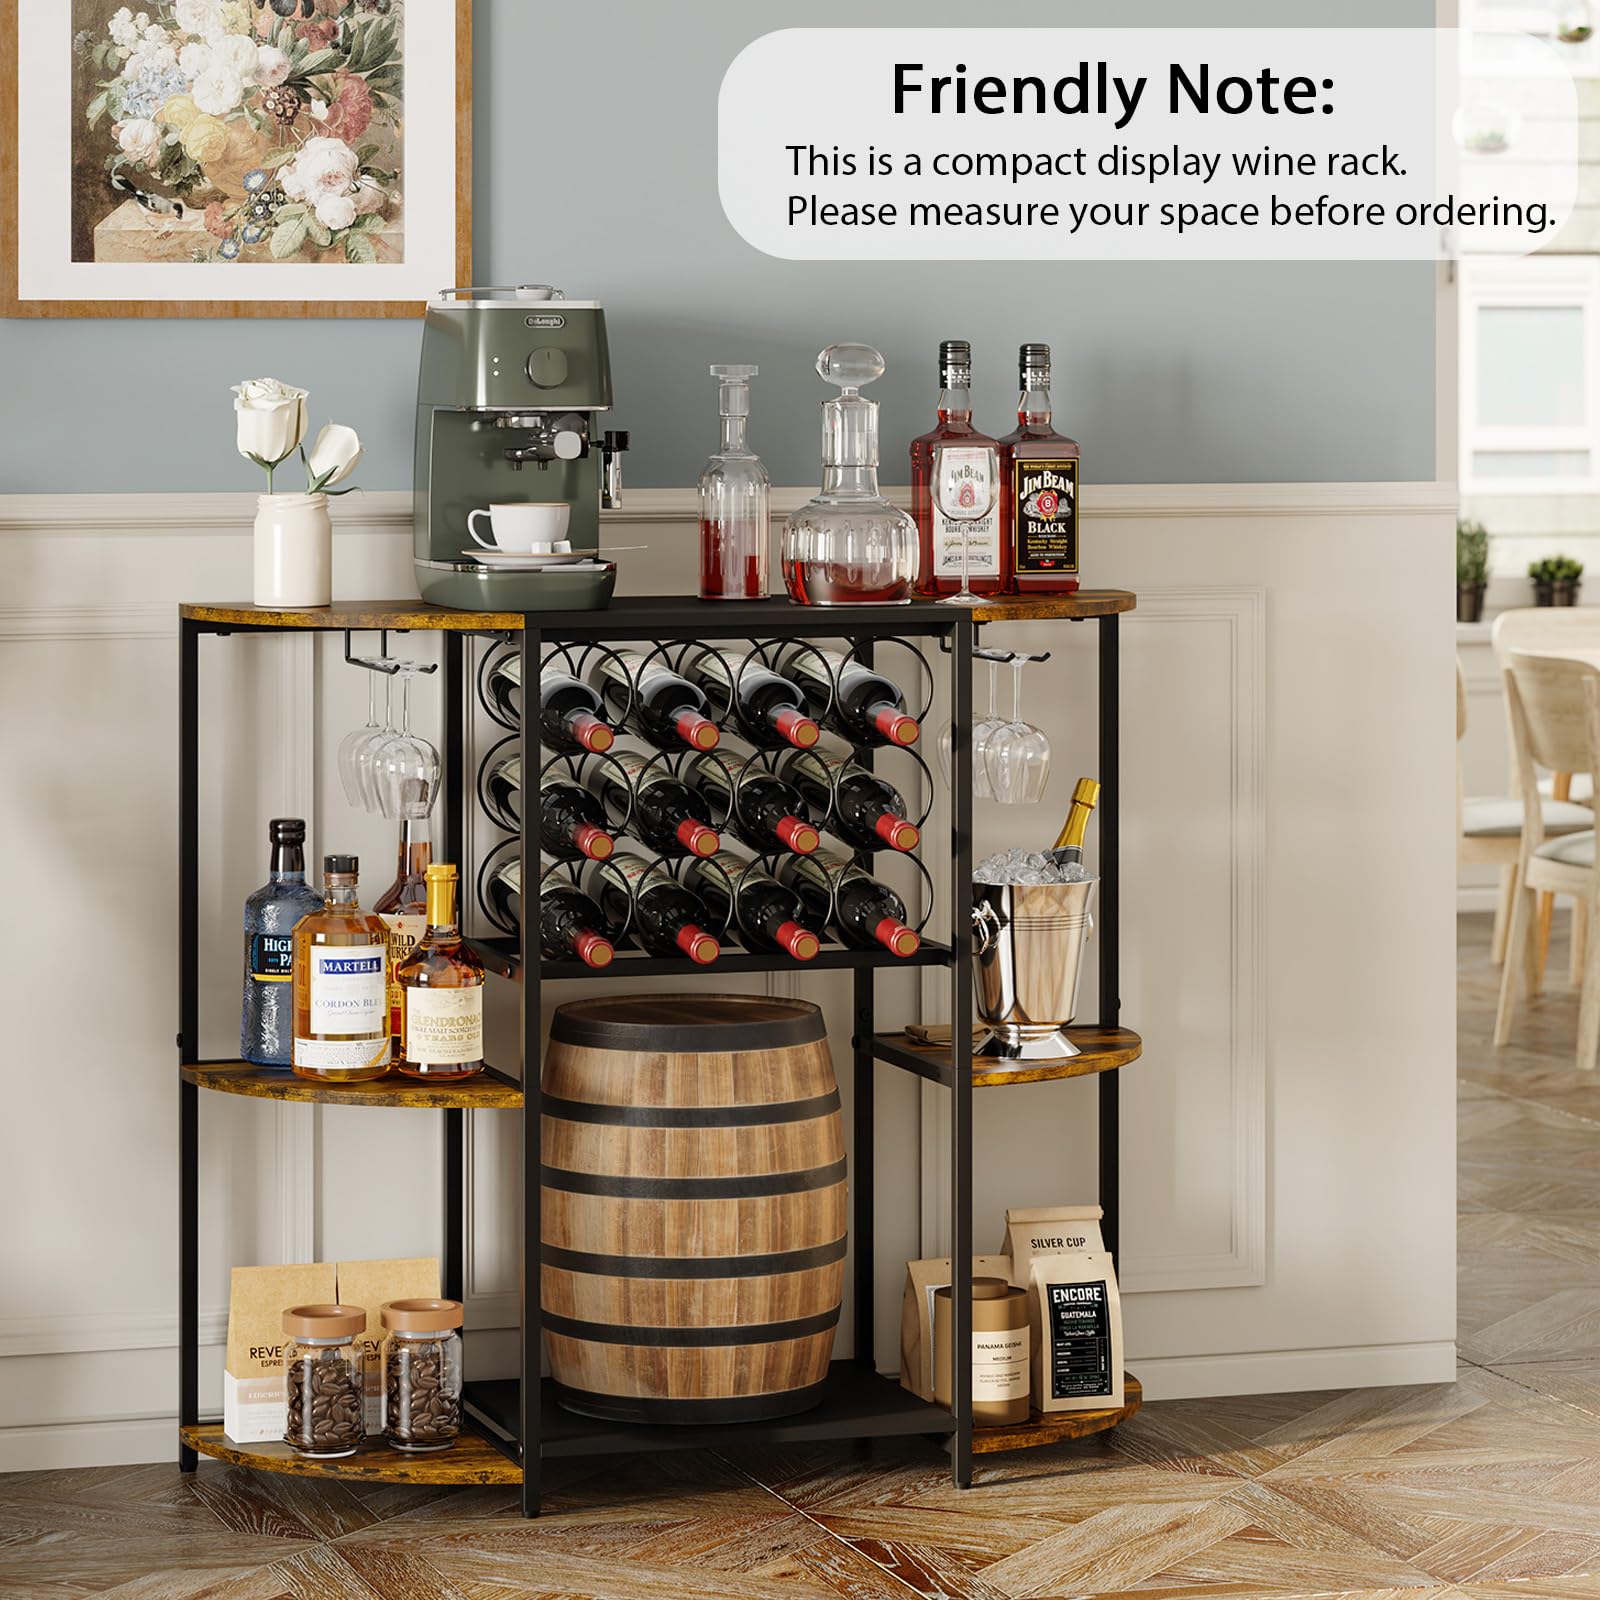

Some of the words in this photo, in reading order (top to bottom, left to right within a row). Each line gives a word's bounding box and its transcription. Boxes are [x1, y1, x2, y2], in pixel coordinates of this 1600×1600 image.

[1020, 475, 1042, 500] JIM
[1043, 470, 1074, 499] BEAM
[1027, 521, 1067, 533] BLACK
[391, 933, 416, 946] WILD
[324, 960, 379, 971] MARTELL
[315, 1000, 360, 1009] CORDON
[1030, 1238, 1064, 1249] SILVER
[1066, 1237, 1086, 1248] CUP
[1053, 1287, 1102, 1303] ENCORE
[1060, 1310, 1097, 1319] GUATEMALA
[249, 1346, 283, 1359] REVE
